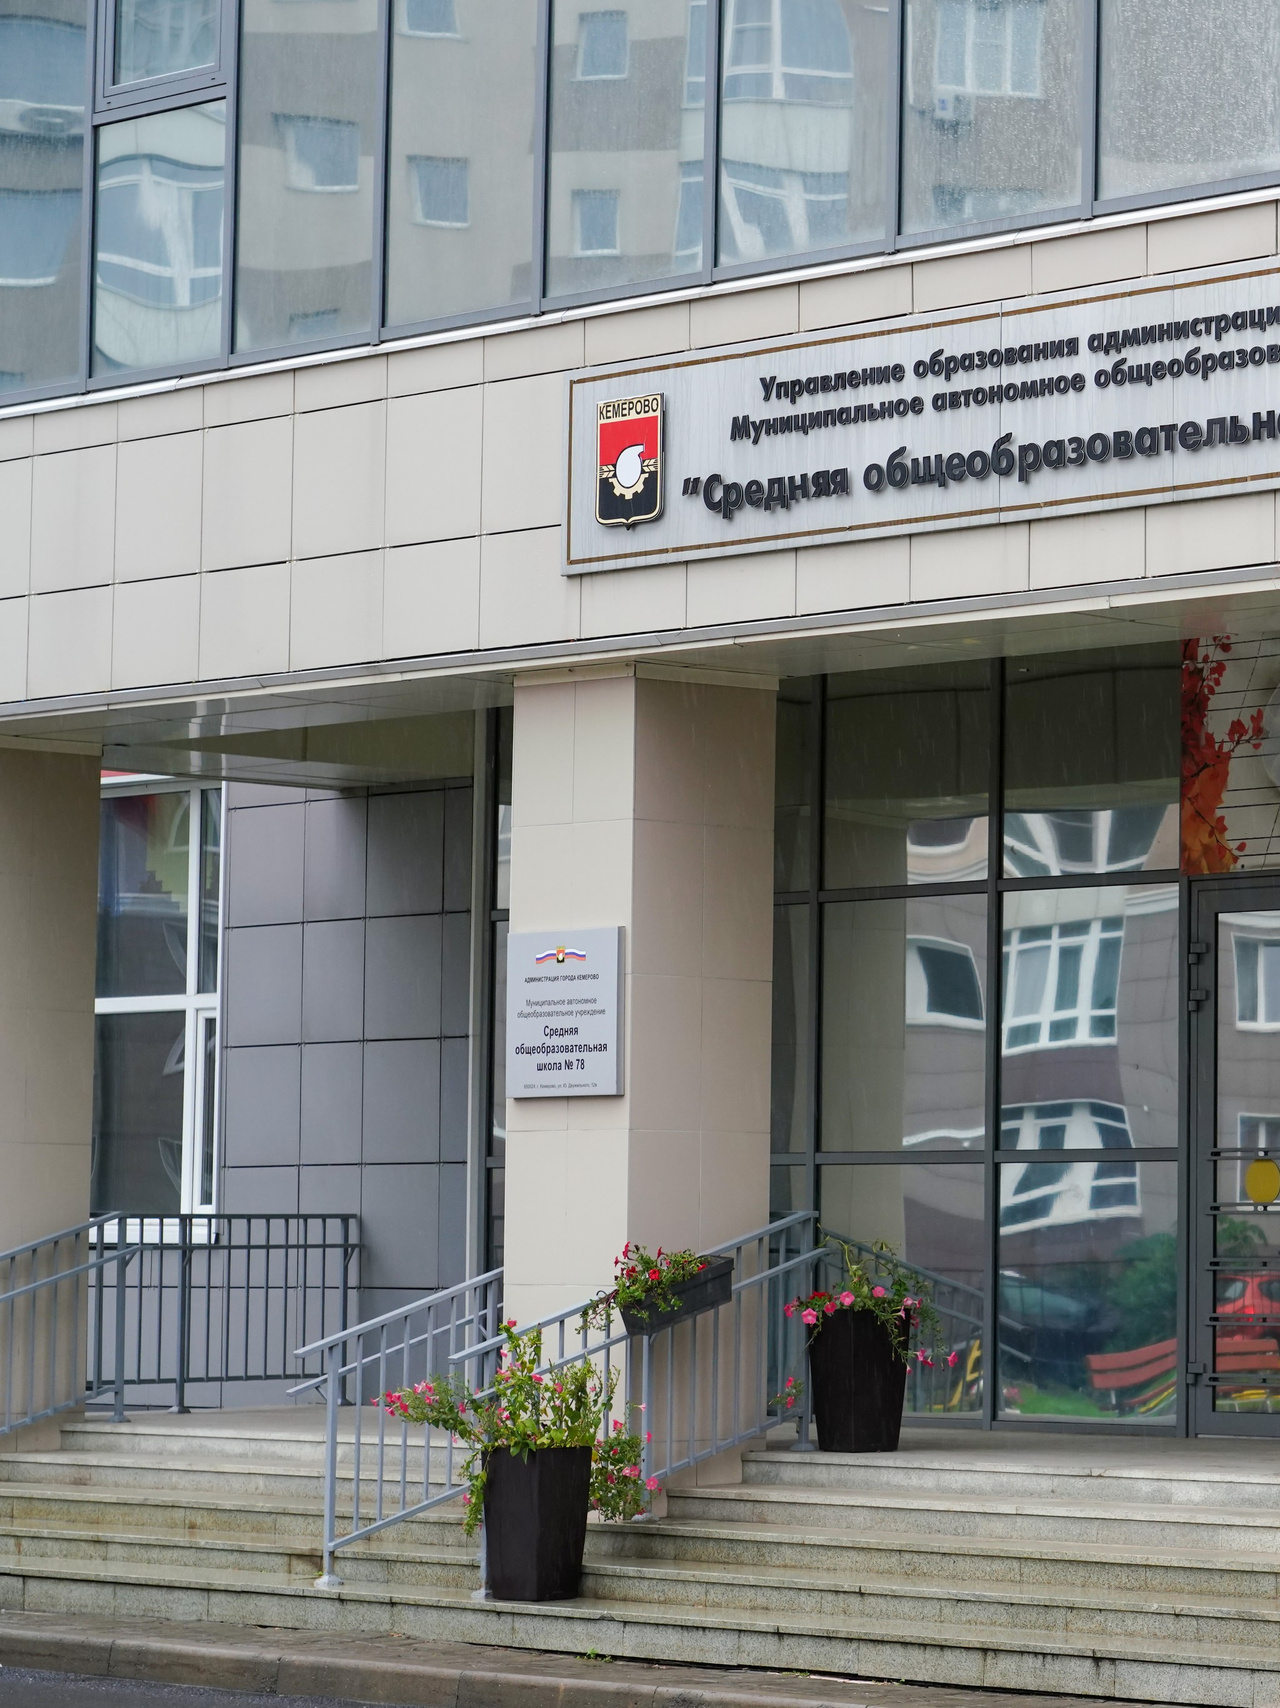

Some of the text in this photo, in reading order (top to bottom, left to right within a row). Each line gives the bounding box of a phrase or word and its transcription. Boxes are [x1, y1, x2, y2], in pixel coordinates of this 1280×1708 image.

[760, 361, 905, 404] Управление
[913, 336, 1079, 382] образования
[598, 398, 660, 422] КЕМЕРОВО
[730, 394, 924, 445] Муниципальное
[931, 371, 1085, 412] автономное
[526, 1000, 566, 1008] Муниципальное
[517, 1009, 606, 1019] общеобразовательное учреждение
[543, 1025, 579, 1039] Средняя
[515, 1042, 608, 1056] общеобразовательная
[537, 1058, 585, 1072] школа № 78
